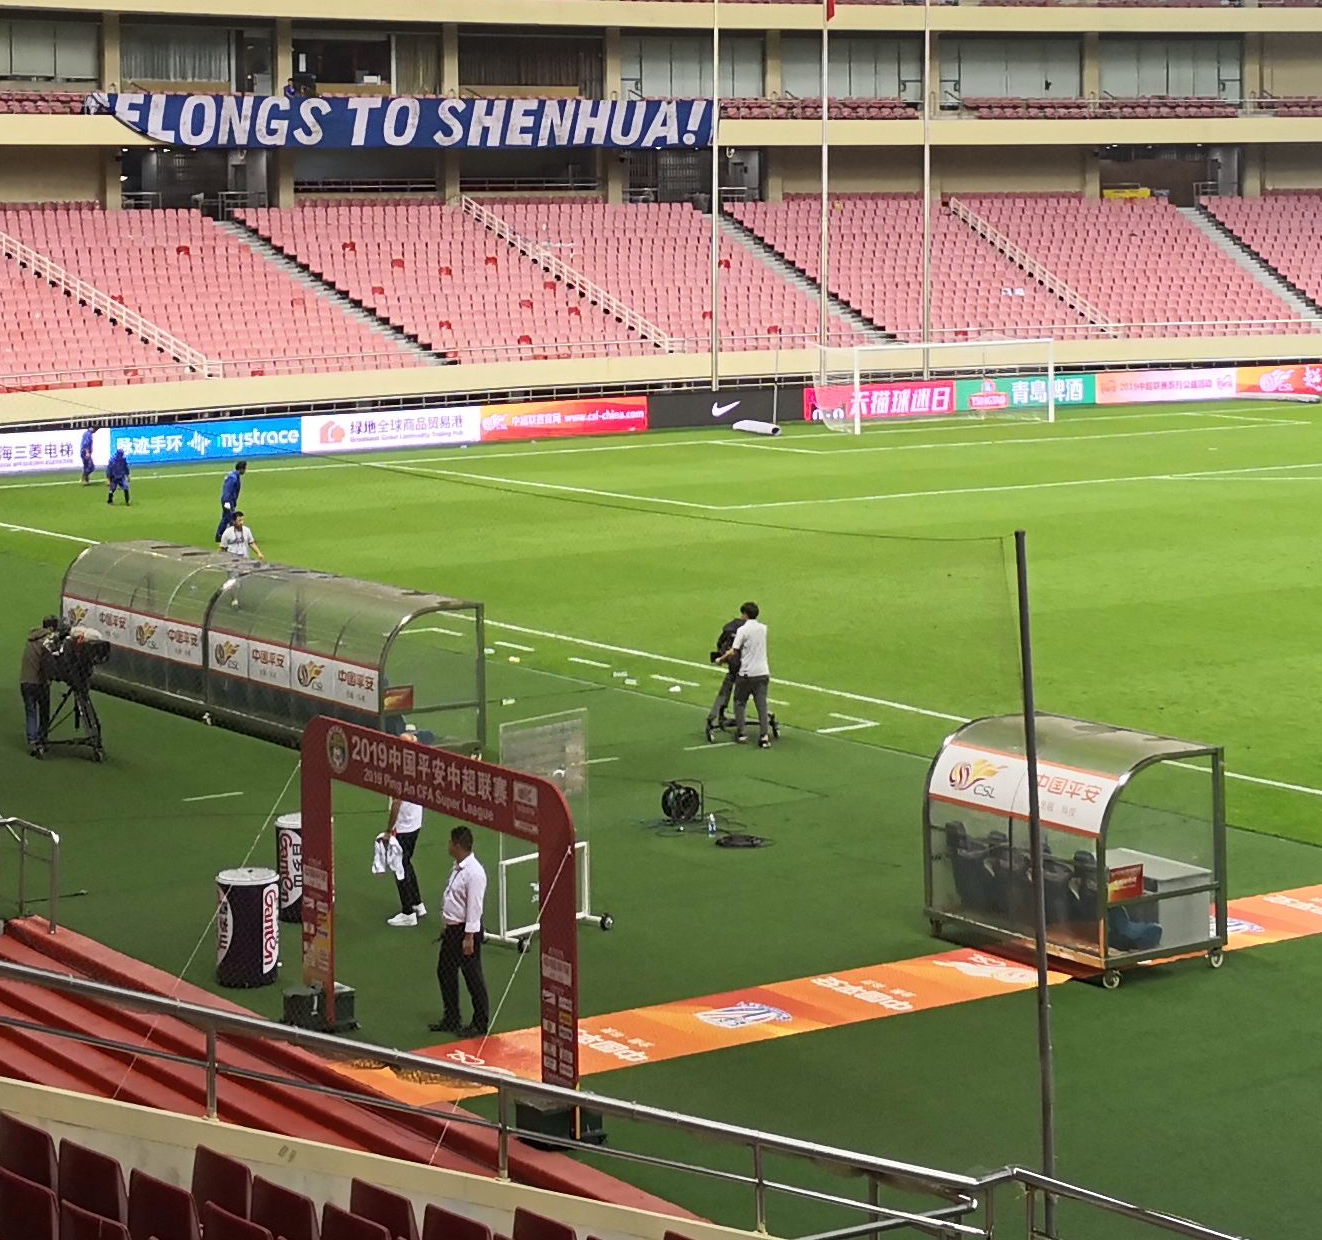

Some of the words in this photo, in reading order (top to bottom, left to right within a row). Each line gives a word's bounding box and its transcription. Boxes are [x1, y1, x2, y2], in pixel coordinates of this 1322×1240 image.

[86, 93, 332, 147] ELONGS
[348, 97, 419, 147] TO
[433, 99, 707, 147] SHENHUA!
[252, 648, 285, 669] 中国平安
[338, 669, 374, 692] 中国平安
[351, 736, 508, 807] 2019中国平安中超联赛
[383, 774, 403, 795] Ping
[403, 780, 416, 796] An
[417, 784, 435, 803] CFA
[435, 791, 461, 811] Super
[462, 800, 494, 822] League
[973, 784, 995, 799] CSL
